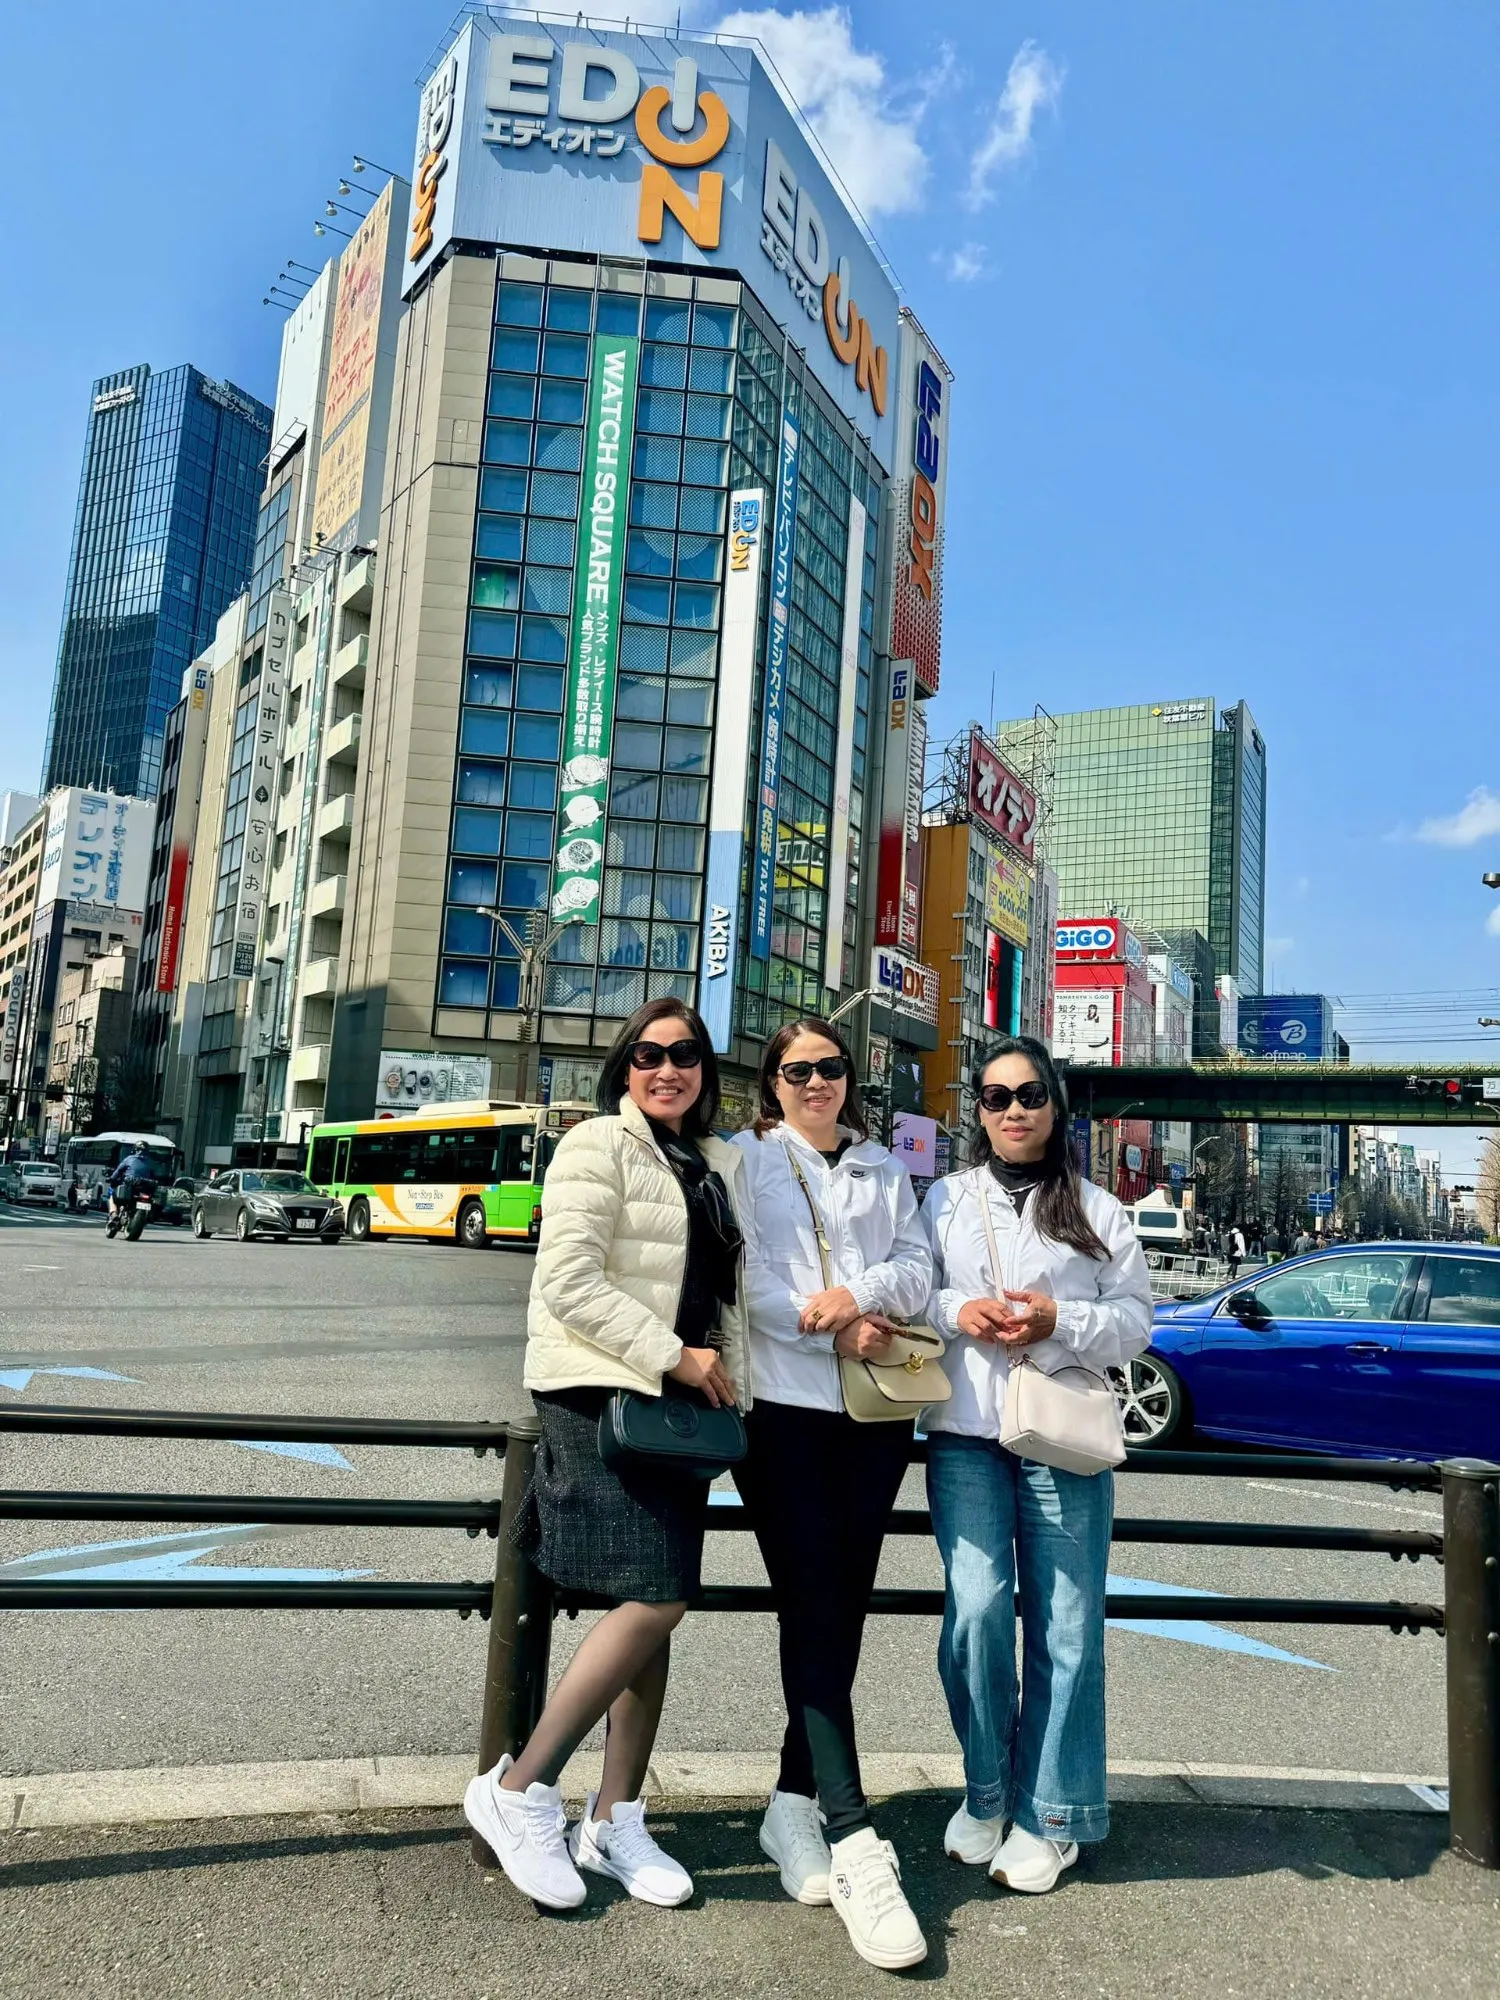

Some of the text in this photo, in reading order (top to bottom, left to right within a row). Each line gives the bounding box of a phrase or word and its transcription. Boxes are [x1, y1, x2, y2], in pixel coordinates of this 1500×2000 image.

[409, 55, 457, 262] EDION
[481, 117, 626, 156] エディオン
[485, 33, 731, 250] EDION
[759, 221, 824, 322] エディオン
[761, 138, 888, 418] EDION
[586, 349, 627, 603] WATCH SQUARE
[731, 499, 760, 572] EDION
[259, 610, 287, 770] カプセルホテル
[976, 760, 1037, 846] オノデン
[69, 793, 109, 898] テレオン
[241, 817, 267, 920] 安心お宿
[759, 858, 769, 896] TAX
[159, 905, 177, 985] Home Electronics Store
[706, 902, 731, 979] AKIBA
[757, 898, 768, 939] FREE
[1055, 928, 1112, 948] GiGO
[5, 973, 23, 1041] sound
[1262, 1049, 1308, 1061] ofmap
